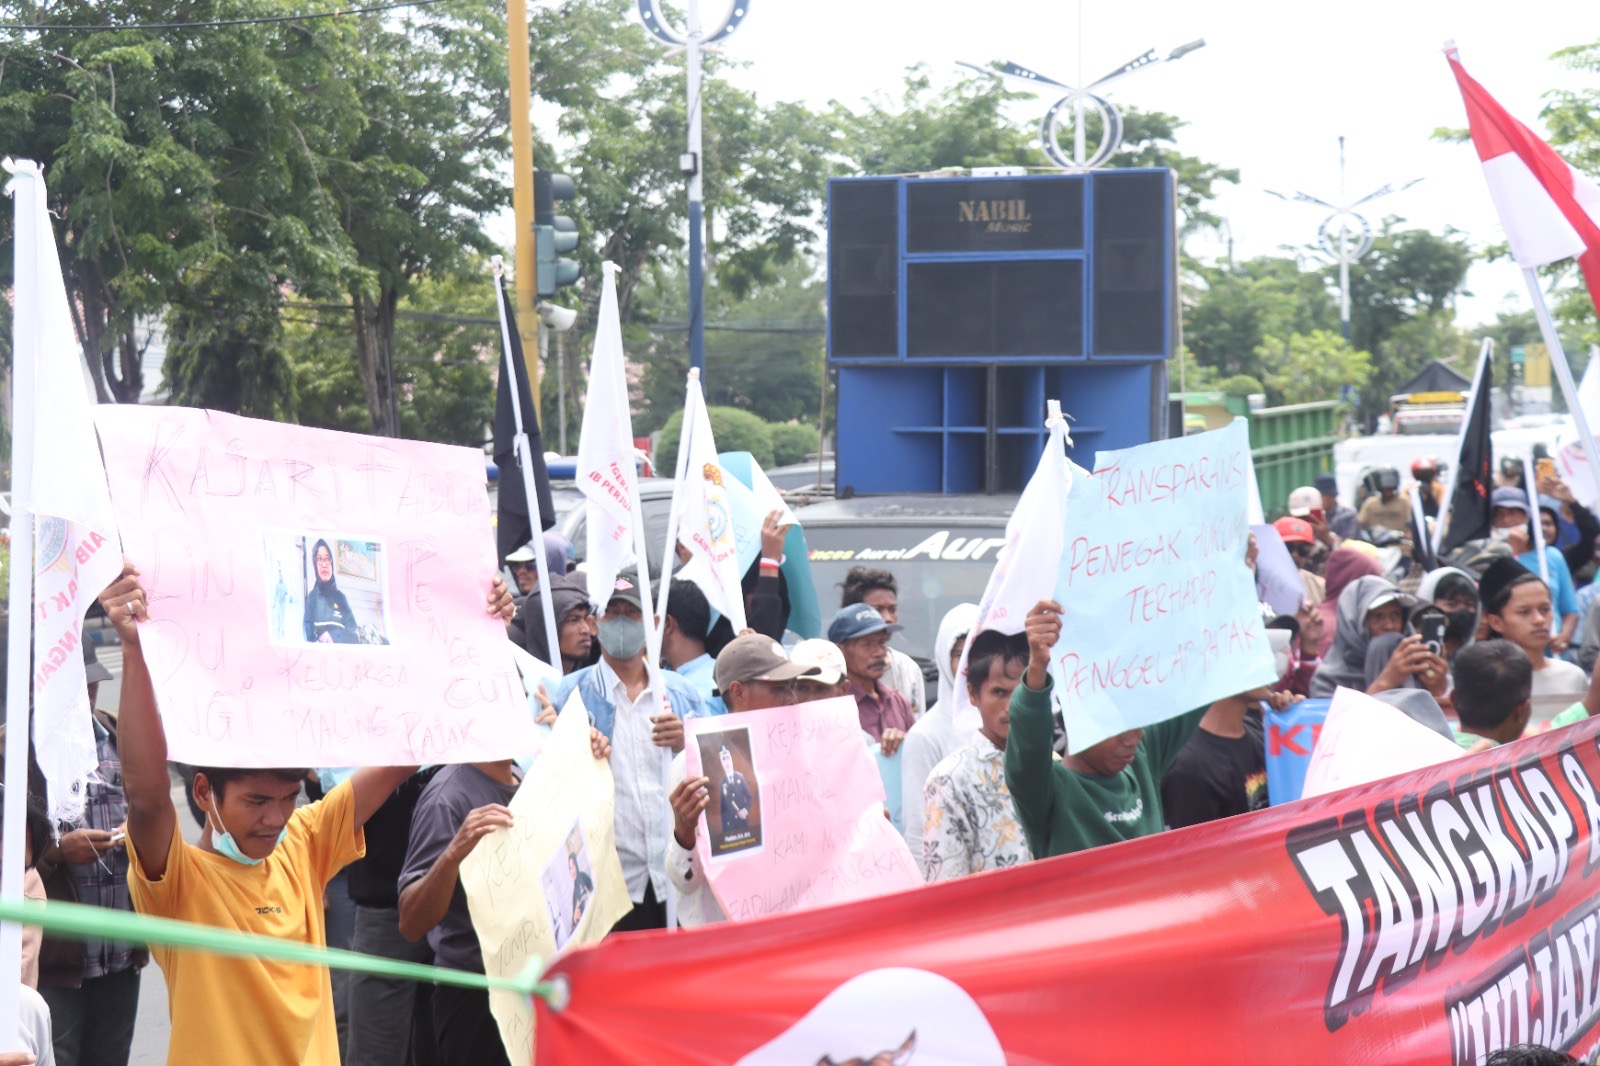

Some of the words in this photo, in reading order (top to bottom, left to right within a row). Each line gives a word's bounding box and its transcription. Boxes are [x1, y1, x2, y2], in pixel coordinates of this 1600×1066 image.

[958, 199, 1032, 222] NABIL
[1068, 530, 1181, 587] PENEGAK
[773, 831, 809, 865] KAMI
[1297, 767, 1574, 1008] TANGKAP
